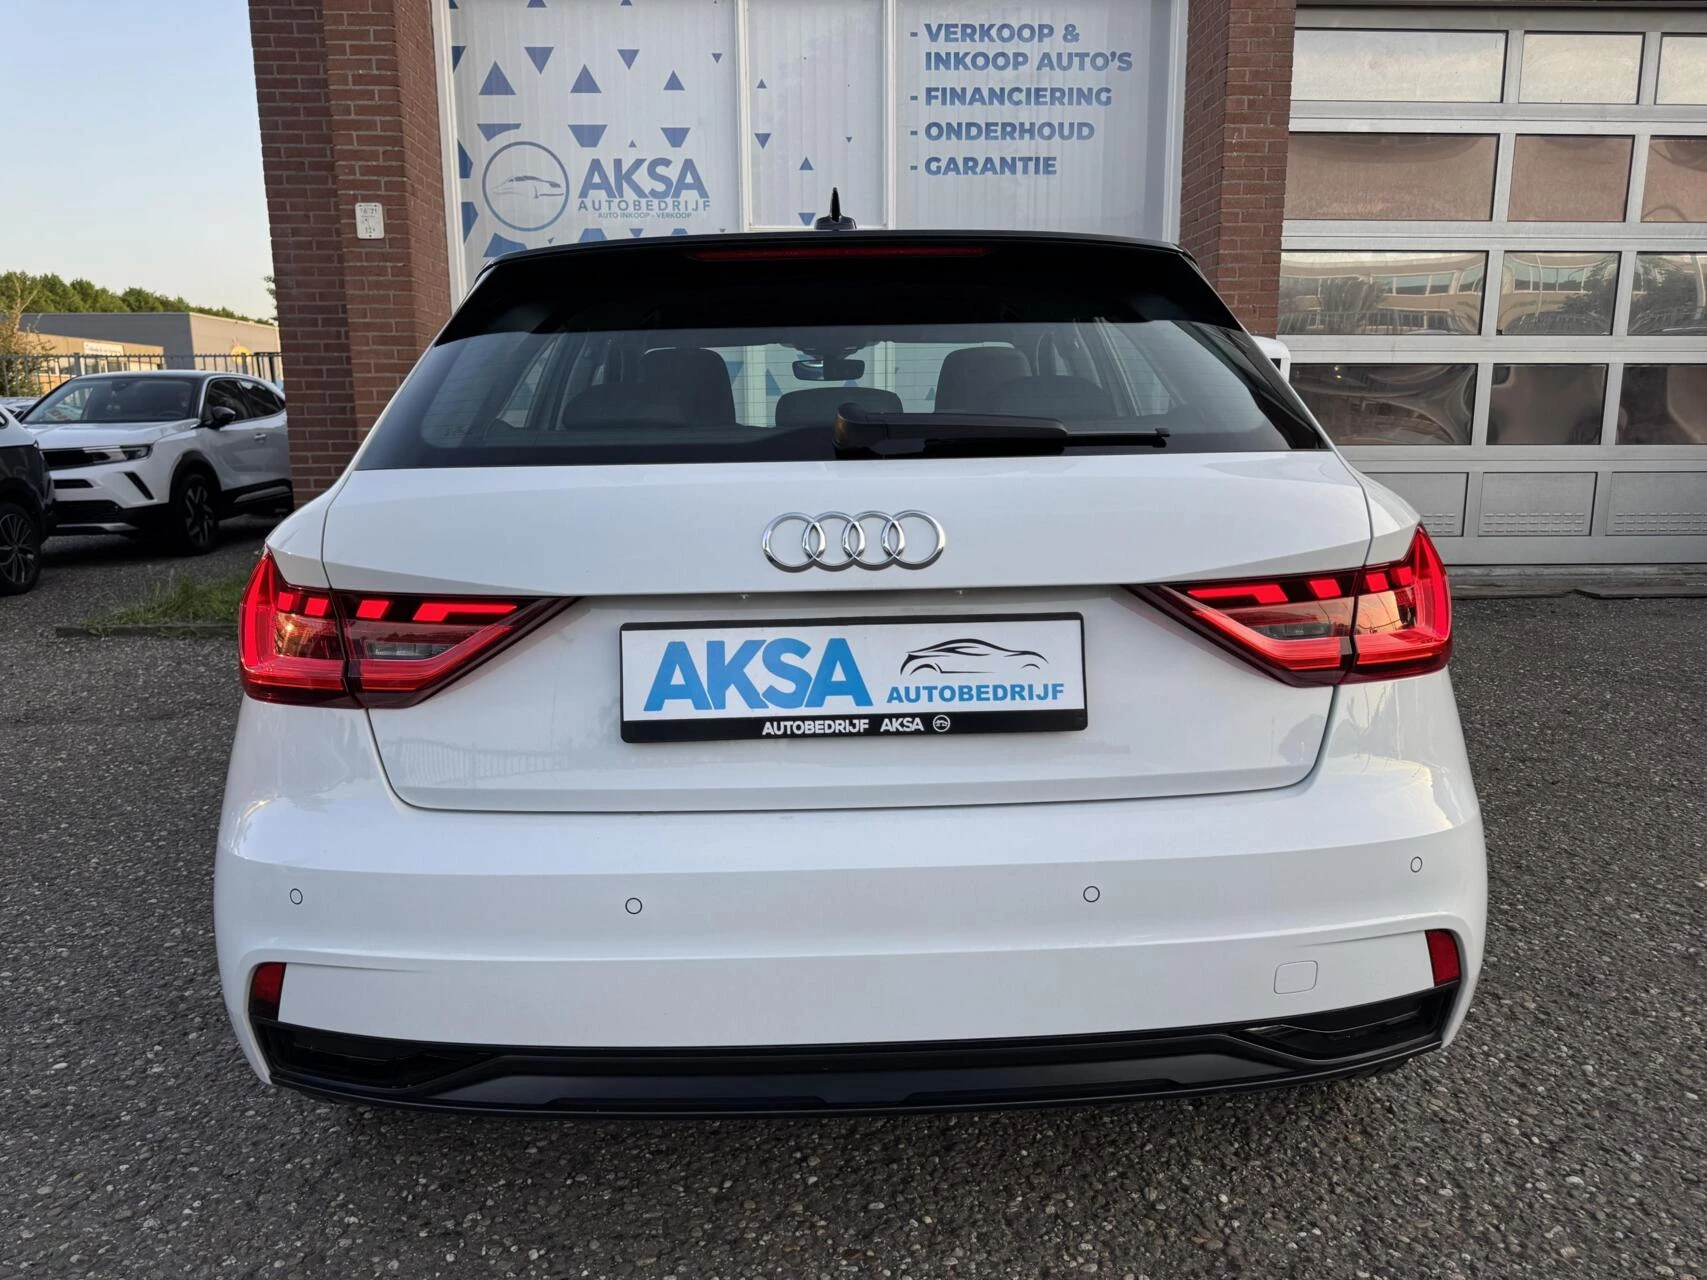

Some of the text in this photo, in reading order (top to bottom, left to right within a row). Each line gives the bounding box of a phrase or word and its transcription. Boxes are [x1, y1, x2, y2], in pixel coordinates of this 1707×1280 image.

[924, 23, 1054, 43] VERKOOP
[1062, 23, 1080, 43] &
[925, 51, 1132, 71] INKOOP AUTO'S
[925, 87, 1112, 106] FINANCIERING
[924, 121, 1095, 141] ONDERHOUD
[924, 156, 1057, 176] GARANTIE
[578, 157, 709, 200] AKSA
[578, 200, 711, 212] AUTOBEDRIJF
[643, 637, 874, 712] AKSA
[886, 683, 1064, 704] AUTOBEDRIJF
[762, 717, 925, 736] AUTOBEDRIJF AKSA
